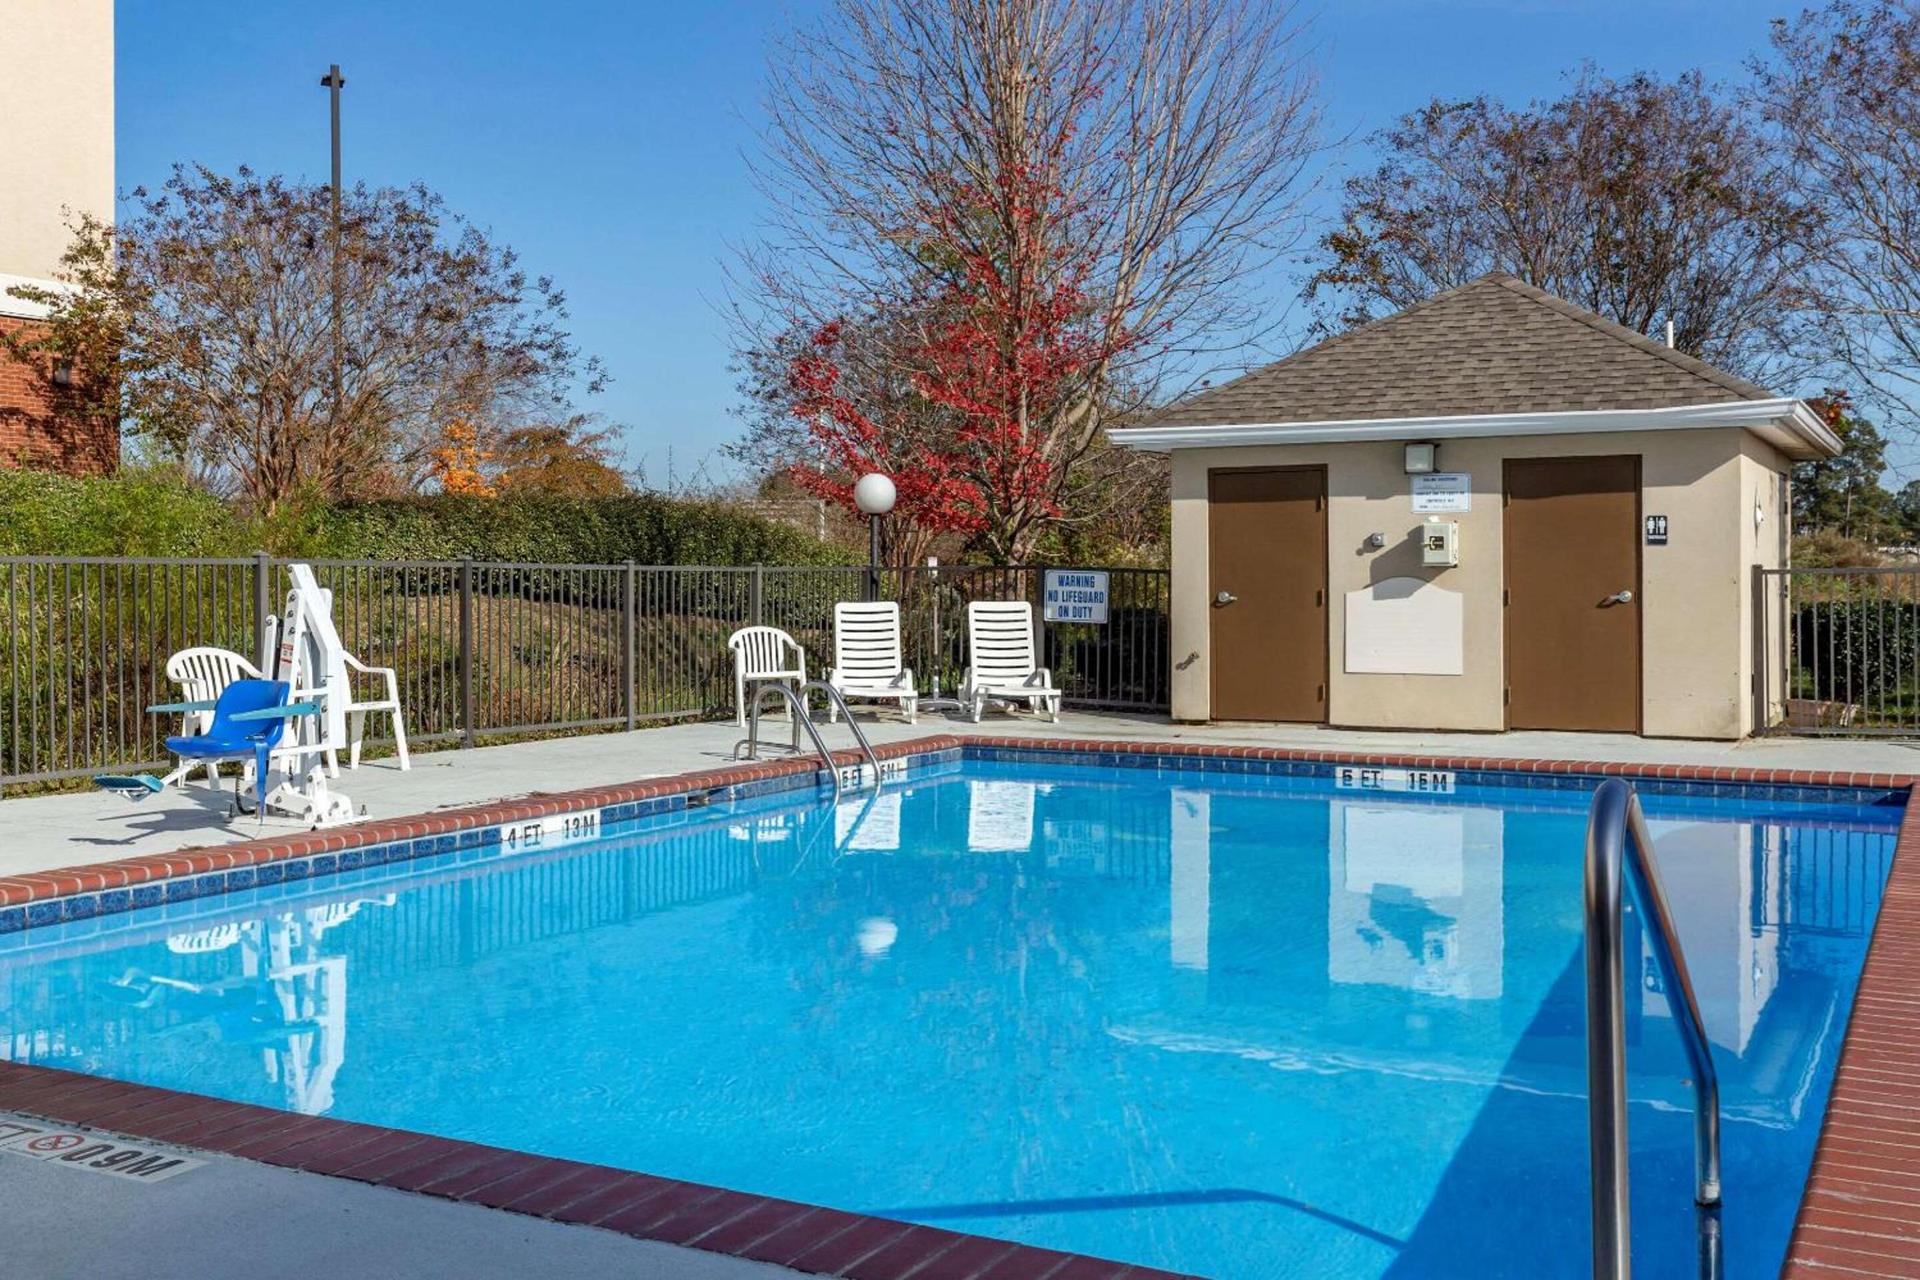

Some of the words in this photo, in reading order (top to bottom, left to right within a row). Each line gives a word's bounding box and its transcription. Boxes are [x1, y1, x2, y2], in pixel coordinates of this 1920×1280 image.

[1058, 575, 1095, 588] WARNING
[1048, 590, 1058, 602] NO
[1062, 591, 1104, 604] LIFEGUARD
[1058, 605, 1069, 617] ON
[1072, 606, 1093, 618] DUTY
